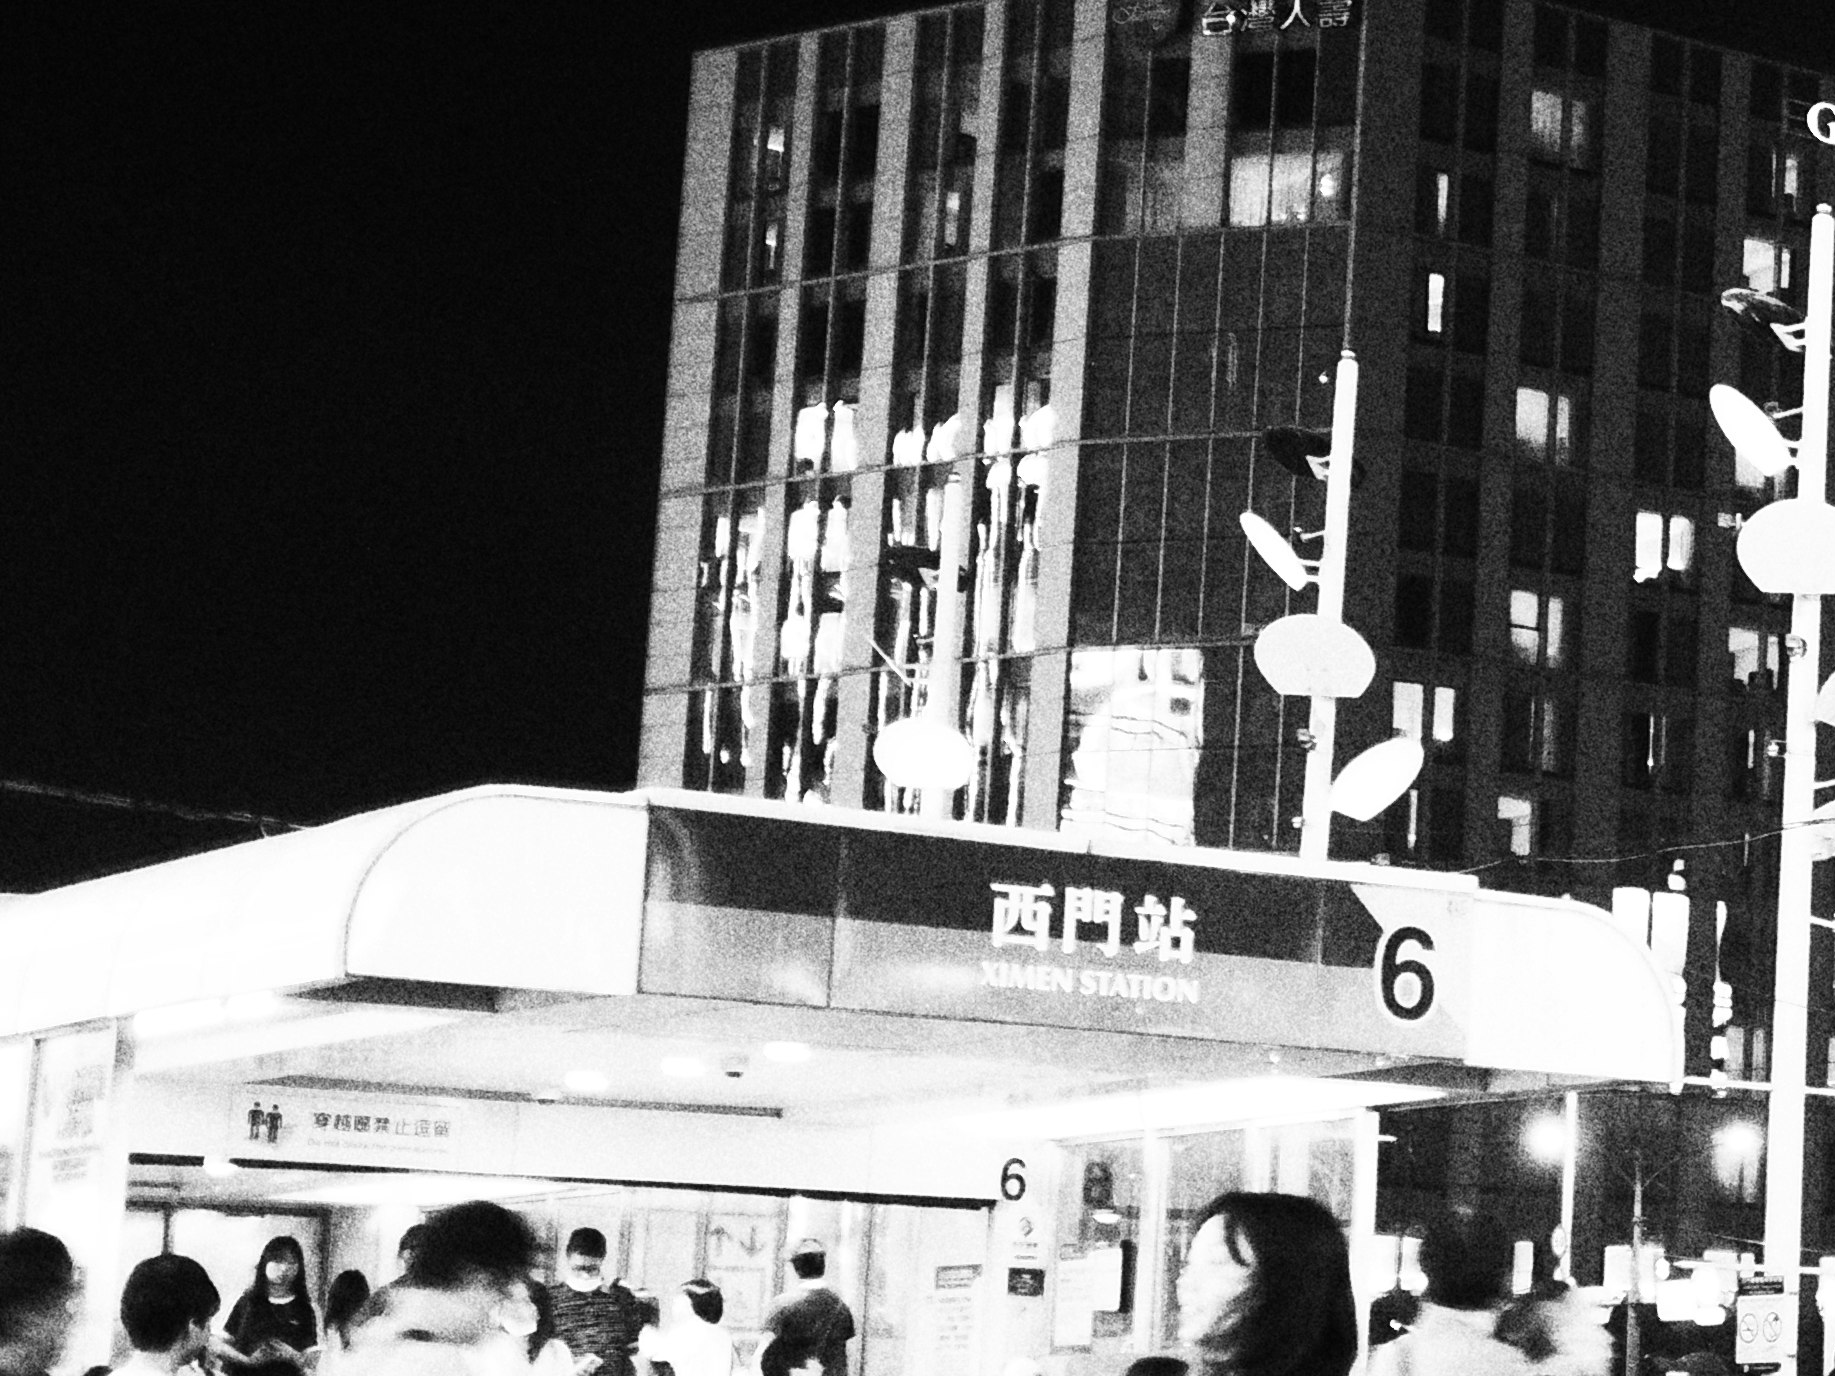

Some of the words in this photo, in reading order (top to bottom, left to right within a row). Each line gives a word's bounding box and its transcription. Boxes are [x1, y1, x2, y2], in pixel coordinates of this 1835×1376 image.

[992, 884, 1197, 964] 西門站
[1379, 925, 1437, 1022] 6
[981, 961, 1073, 992] XIMEN
[1080, 969, 1199, 1004] STATION
[1001, 1157, 1026, 1202] 6
